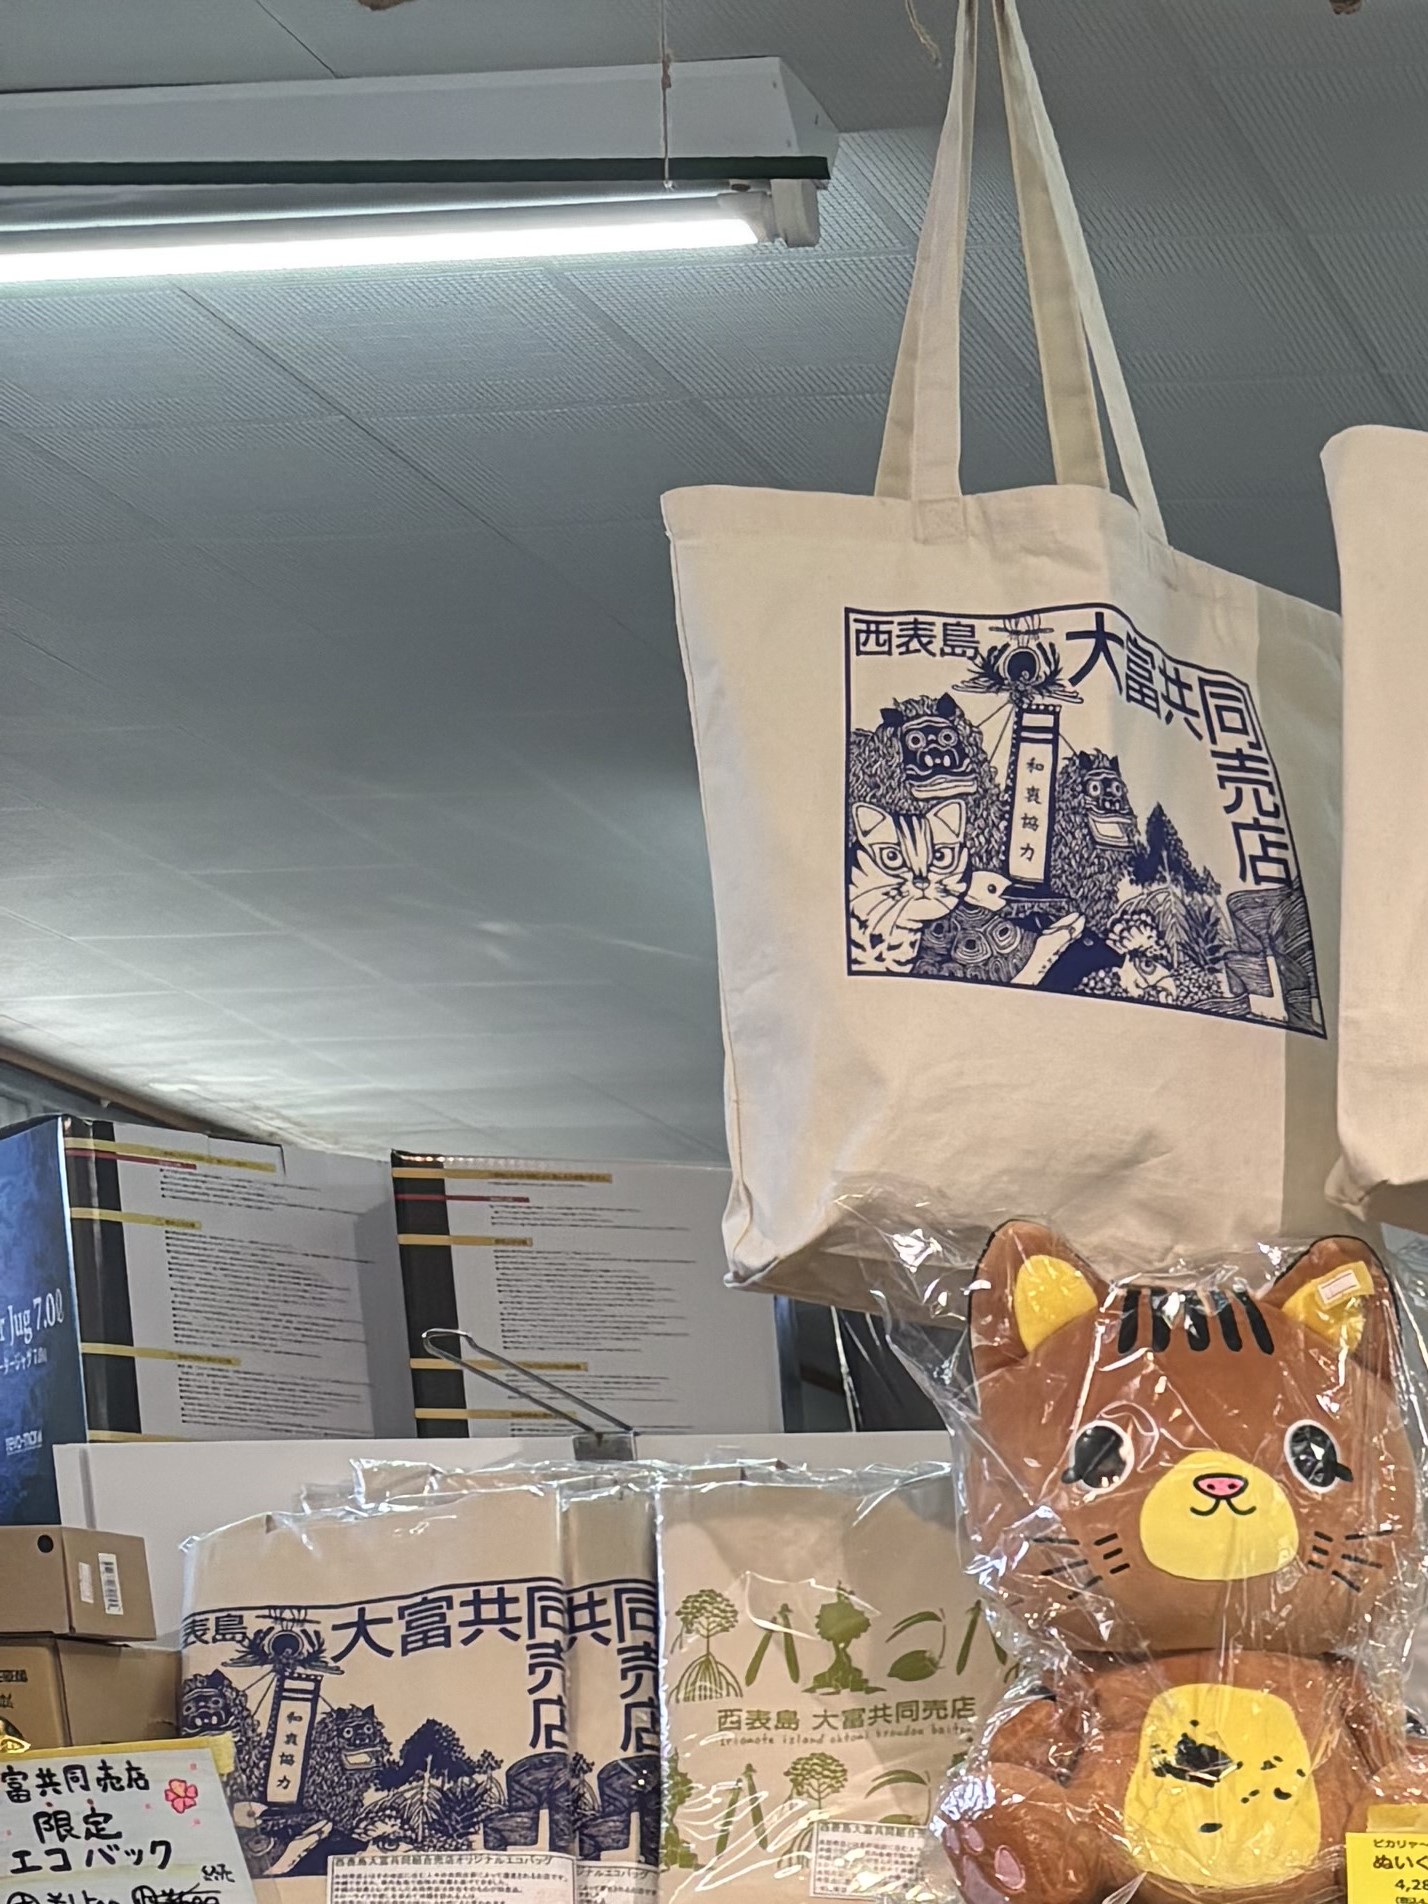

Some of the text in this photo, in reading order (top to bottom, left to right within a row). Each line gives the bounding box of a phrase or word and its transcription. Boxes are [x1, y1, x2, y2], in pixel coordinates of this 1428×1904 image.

[853, 618, 981, 660] 西表島
[1065, 611, 1293, 888] 大富共同売店
[9, 1303, 33, 1347] Jug
[331, 1586, 568, 1750] 大富共同売店
[717, 1696, 977, 1732] 西表島 大富共同売店
[33, 1808, 124, 1843] 限定
[10, 1839, 173, 1872] エコバック
